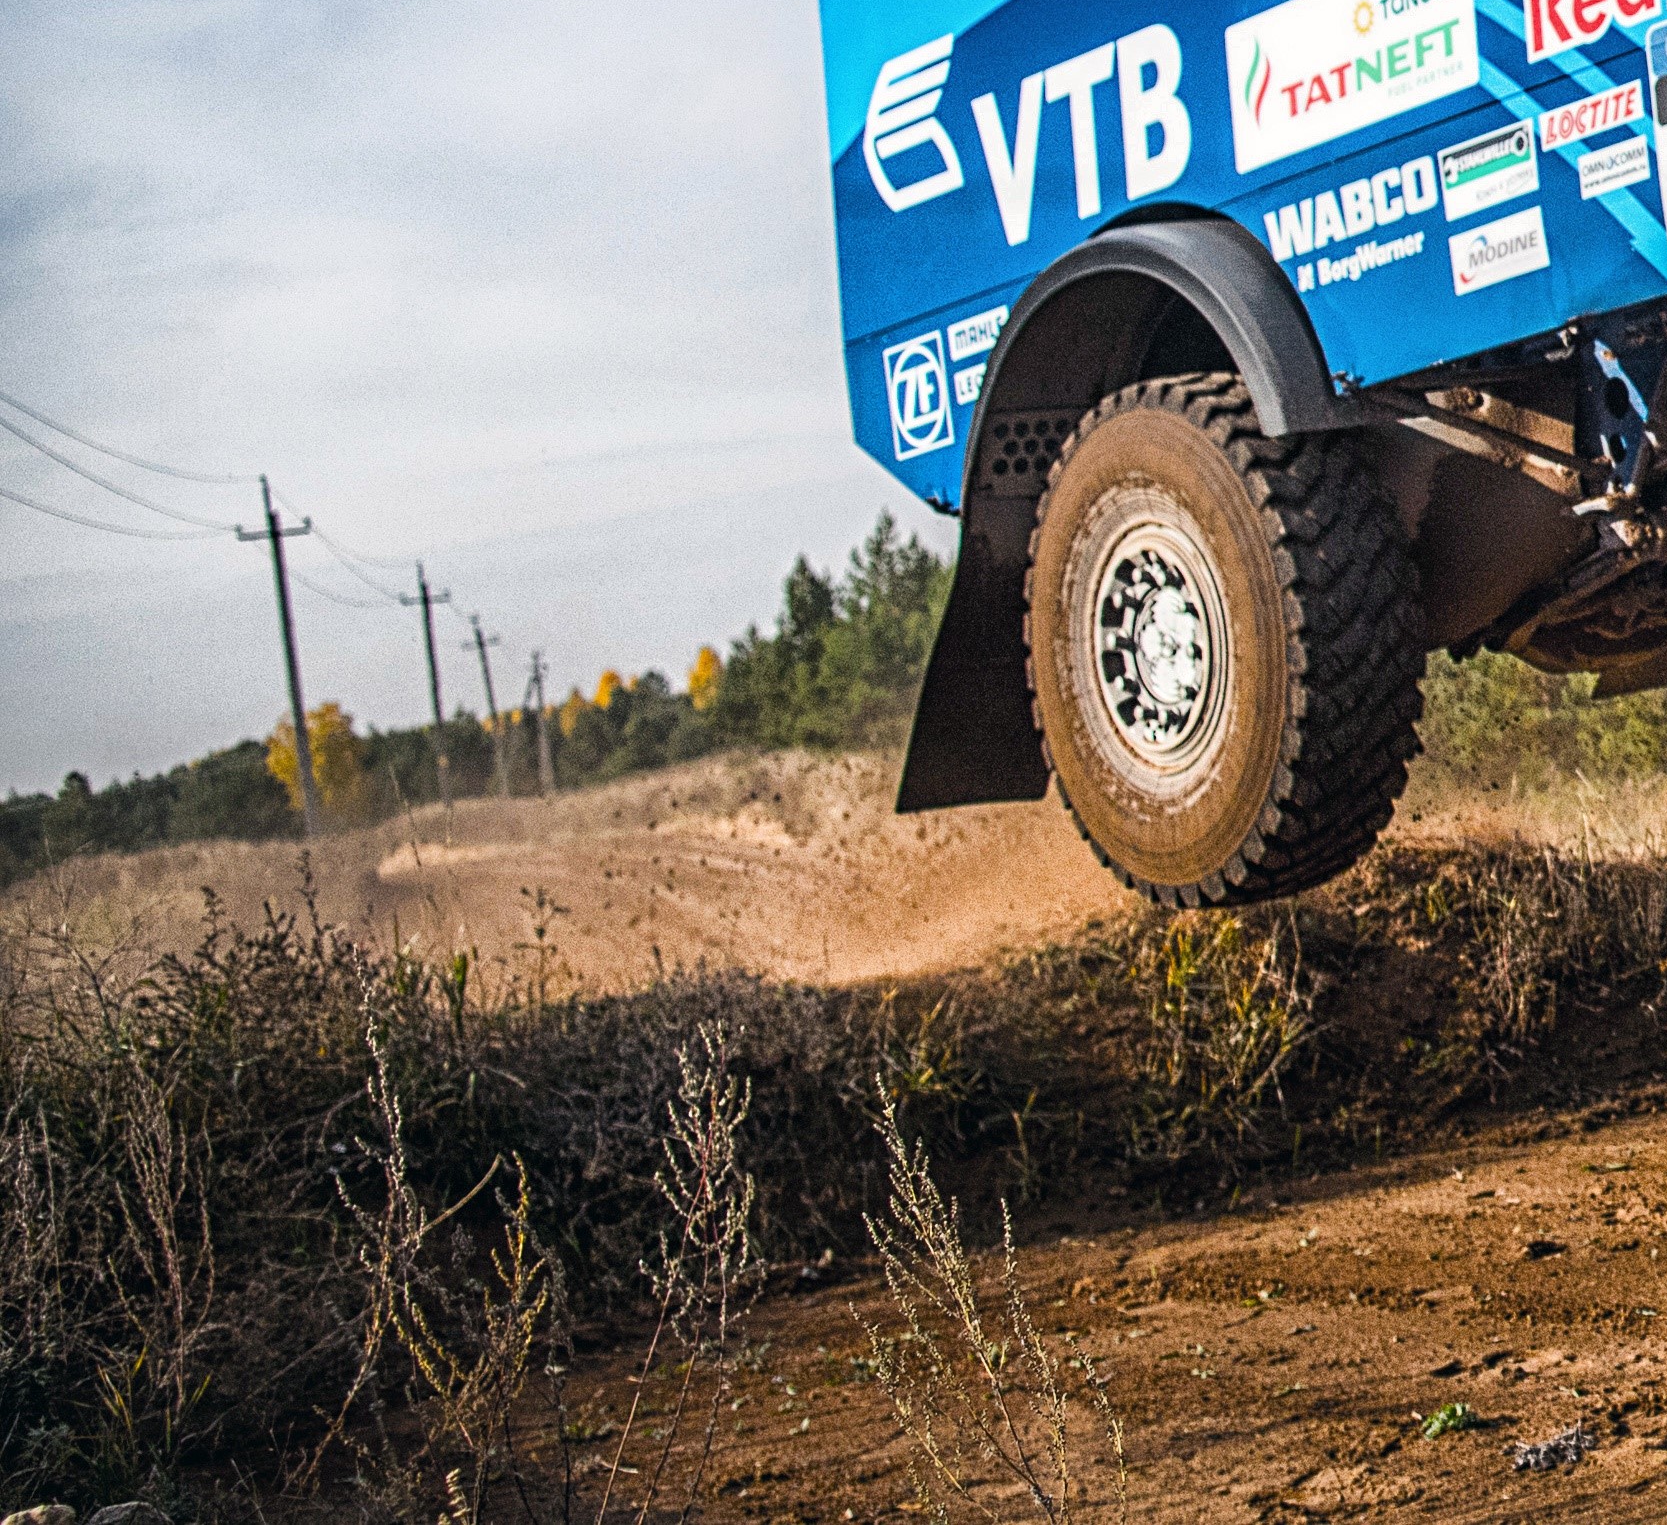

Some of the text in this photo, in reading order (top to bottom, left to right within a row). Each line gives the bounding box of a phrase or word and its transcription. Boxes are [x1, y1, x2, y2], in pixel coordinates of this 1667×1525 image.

[1280, 17, 1461, 119] TATNEFT
[970, 22, 1192, 248] VTB
[1545, 86, 1638, 145] LOCTITE
[1262, 154, 1440, 264] WABCO
[1317, 230, 1425, 288] BorgWarner
[1468, 229, 1538, 268] MODINE
[896, 361, 942, 431] ZF
